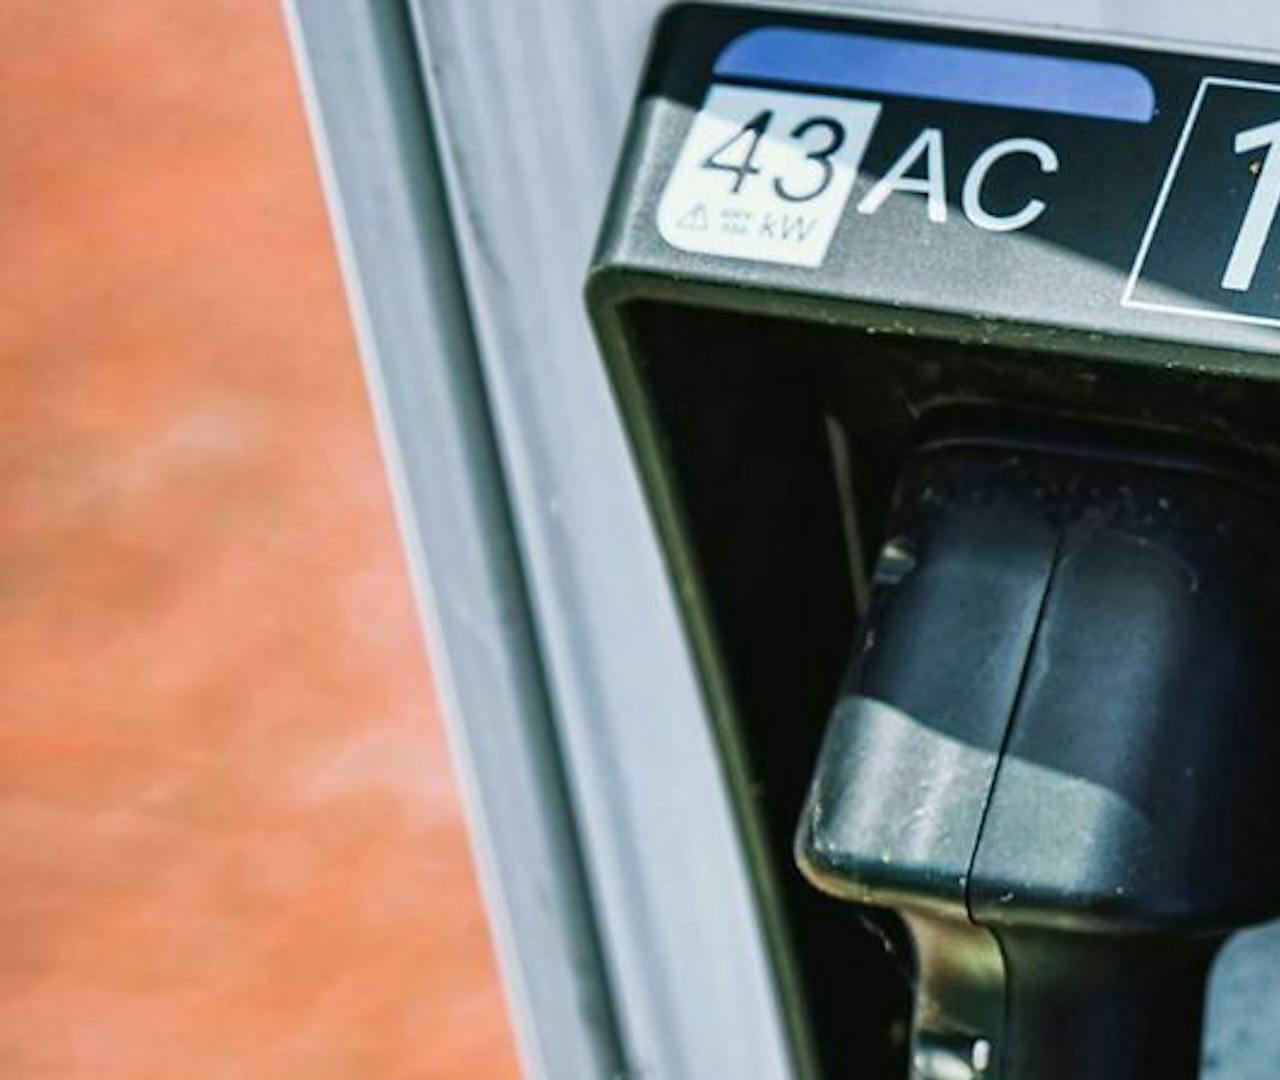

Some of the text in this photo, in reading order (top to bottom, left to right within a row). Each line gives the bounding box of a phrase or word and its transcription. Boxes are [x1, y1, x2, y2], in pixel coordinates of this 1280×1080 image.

[701, 109, 846, 202] 43
[857, 128, 1059, 231] AC
[760, 211, 818, 242] kW
